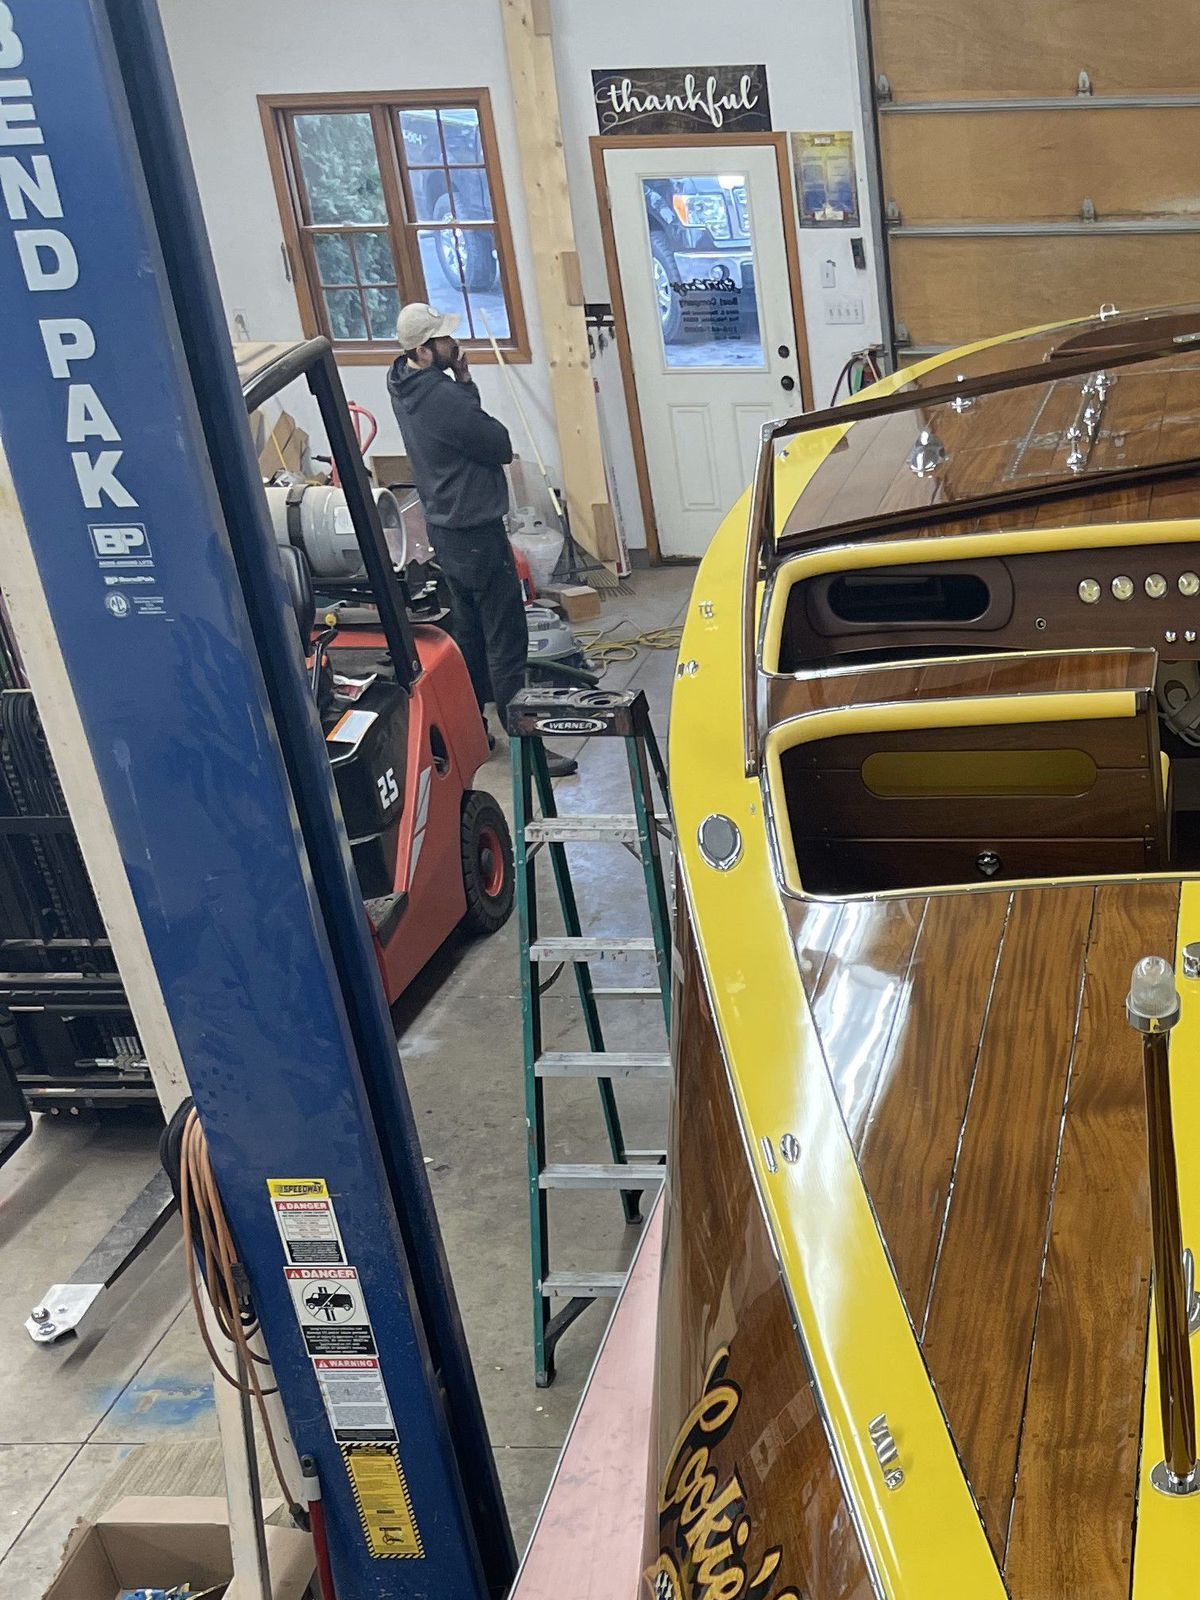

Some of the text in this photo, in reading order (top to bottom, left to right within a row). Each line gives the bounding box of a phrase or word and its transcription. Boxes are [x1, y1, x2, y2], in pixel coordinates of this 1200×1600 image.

[607, 73, 758, 128] thankful
[38, 318, 139, 509] PAK
[93, 528, 145, 554] BP
[548, 721, 593, 730] WERNER
[377, 768, 400, 810] 25
[283, 1184, 323, 1193] SPEEDWAY
[286, 1202, 327, 1210] DANGER
[301, 1269, 355, 1279] DANGER
[328, 1358, 374, 1368] WARNING
